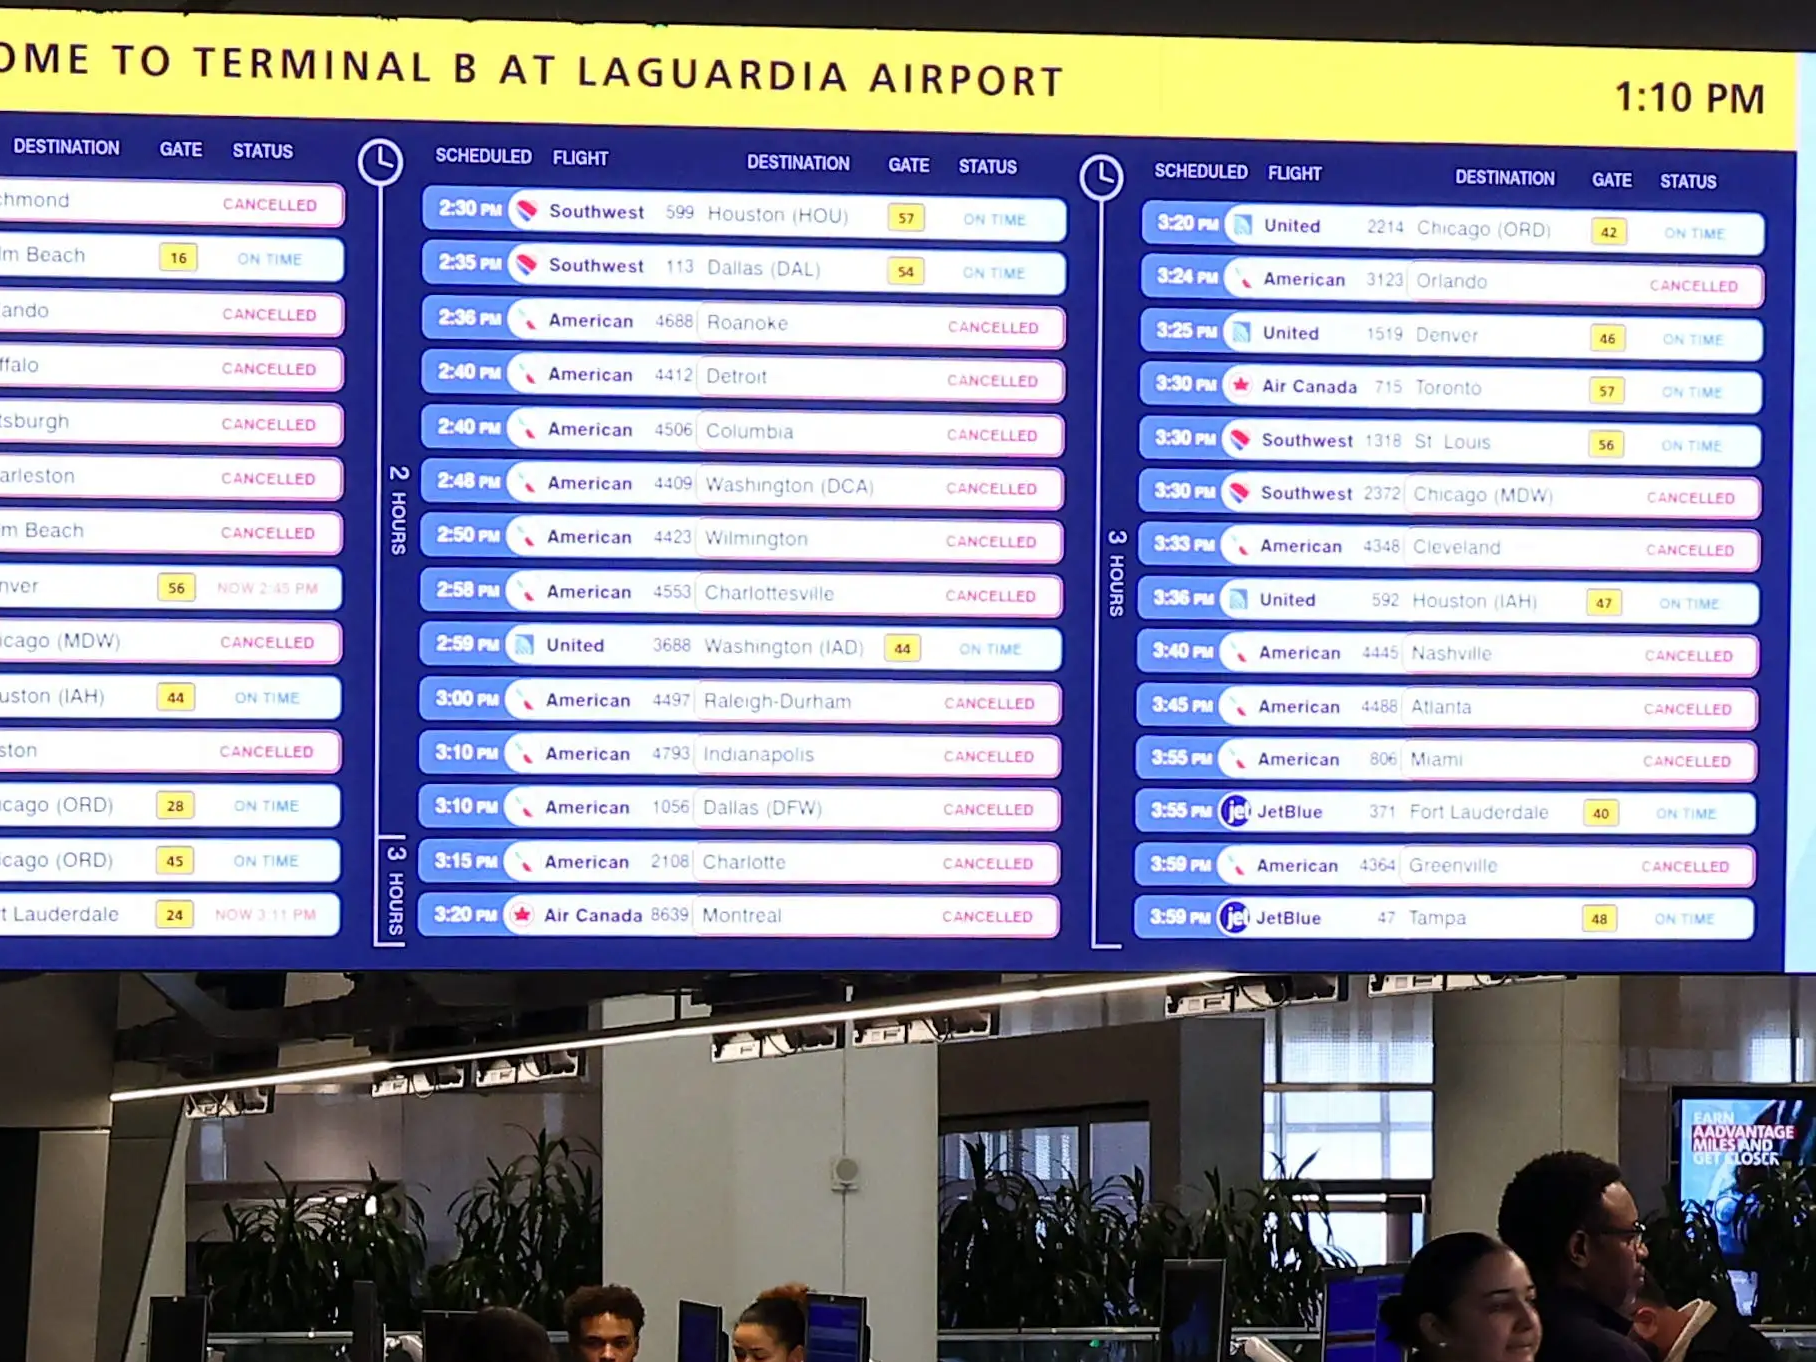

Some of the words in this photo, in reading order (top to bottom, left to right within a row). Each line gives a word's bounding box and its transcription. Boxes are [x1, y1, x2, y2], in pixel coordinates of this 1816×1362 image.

[112, 45, 169, 76] TO
[193, 47, 430, 82] TERMINAL
[455, 53, 475, 83] B
[499, 55, 555, 85] AT
[580, 56, 846, 91] LAGUARDIA
[870, 63, 1062, 96] AIRPORT
[1617, 81, 1691, 112] 1:10
[1708, 83, 1763, 114] PM
[14, 138, 119, 155] DESTINATION
[160, 142, 202, 156] GATE
[233, 143, 293, 158] STATUS
[436, 148, 532, 164] SCHEDULED
[554, 150, 609, 165] FLIGHT
[748, 154, 849, 170] DESTINATION
[889, 158, 929, 172] GATE
[960, 159, 1017, 174] STATUS
[1155, 163, 1248, 179] SCHEDULED
[1269, 165, 1322, 180] FLIGHT
[1456, 169, 1554, 185] DESTINATION
[1593, 172, 1632, 187] GATE
[1661, 174, 1716, 189] STATUS
[550, 204, 644, 219] Southwest
[1264, 326, 1319, 340] United
[390, 466, 409, 479] 2
[391, 491, 407, 556] HOURS
[1109, 530, 1126, 545] 3
[1110, 556, 1124, 616] HOURS
[546, 693, 630, 707] American
[1258, 805, 1322, 818] JetBlue
[388, 847, 406, 860] 3
[389, 874, 403, 935] HOURS
[1693, 1112, 1734, 1124] EARN
[1693, 1126, 1795, 1139] AADVANTAGE
[1693, 1139, 1735, 1152] MILES
[1738, 1139, 1773, 1152] AND
[1693, 1153, 1723, 1165] GET
